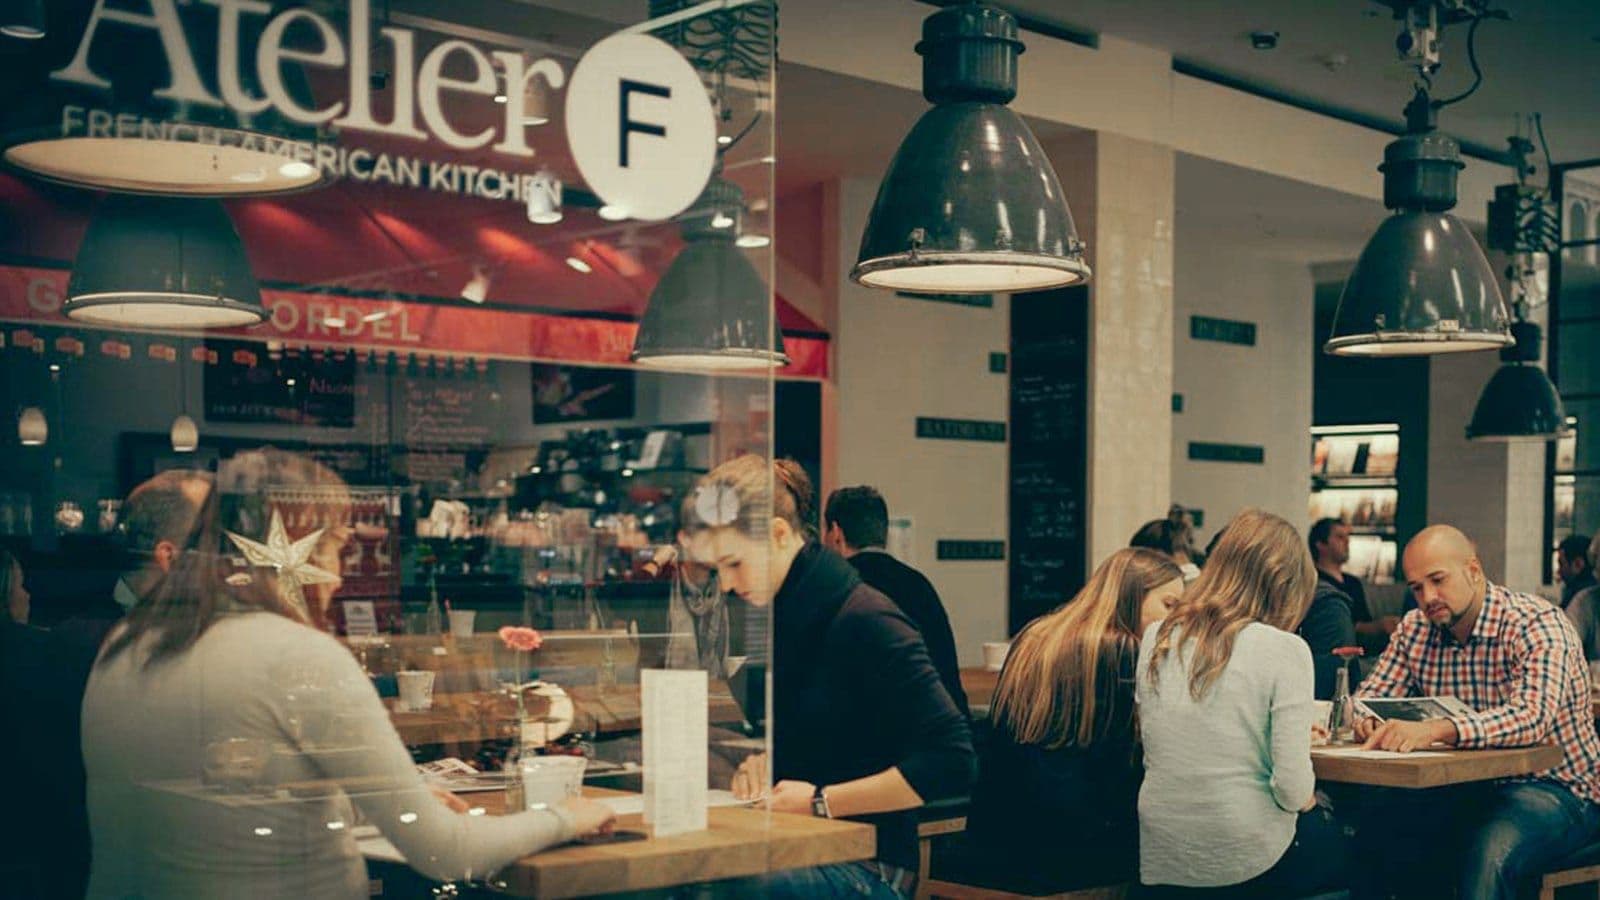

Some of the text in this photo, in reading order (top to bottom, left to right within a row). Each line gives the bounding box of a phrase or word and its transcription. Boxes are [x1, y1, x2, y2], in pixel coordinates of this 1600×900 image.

[49, 0, 671, 169] Atelier F
[429, 161, 563, 206] KITCHEN
